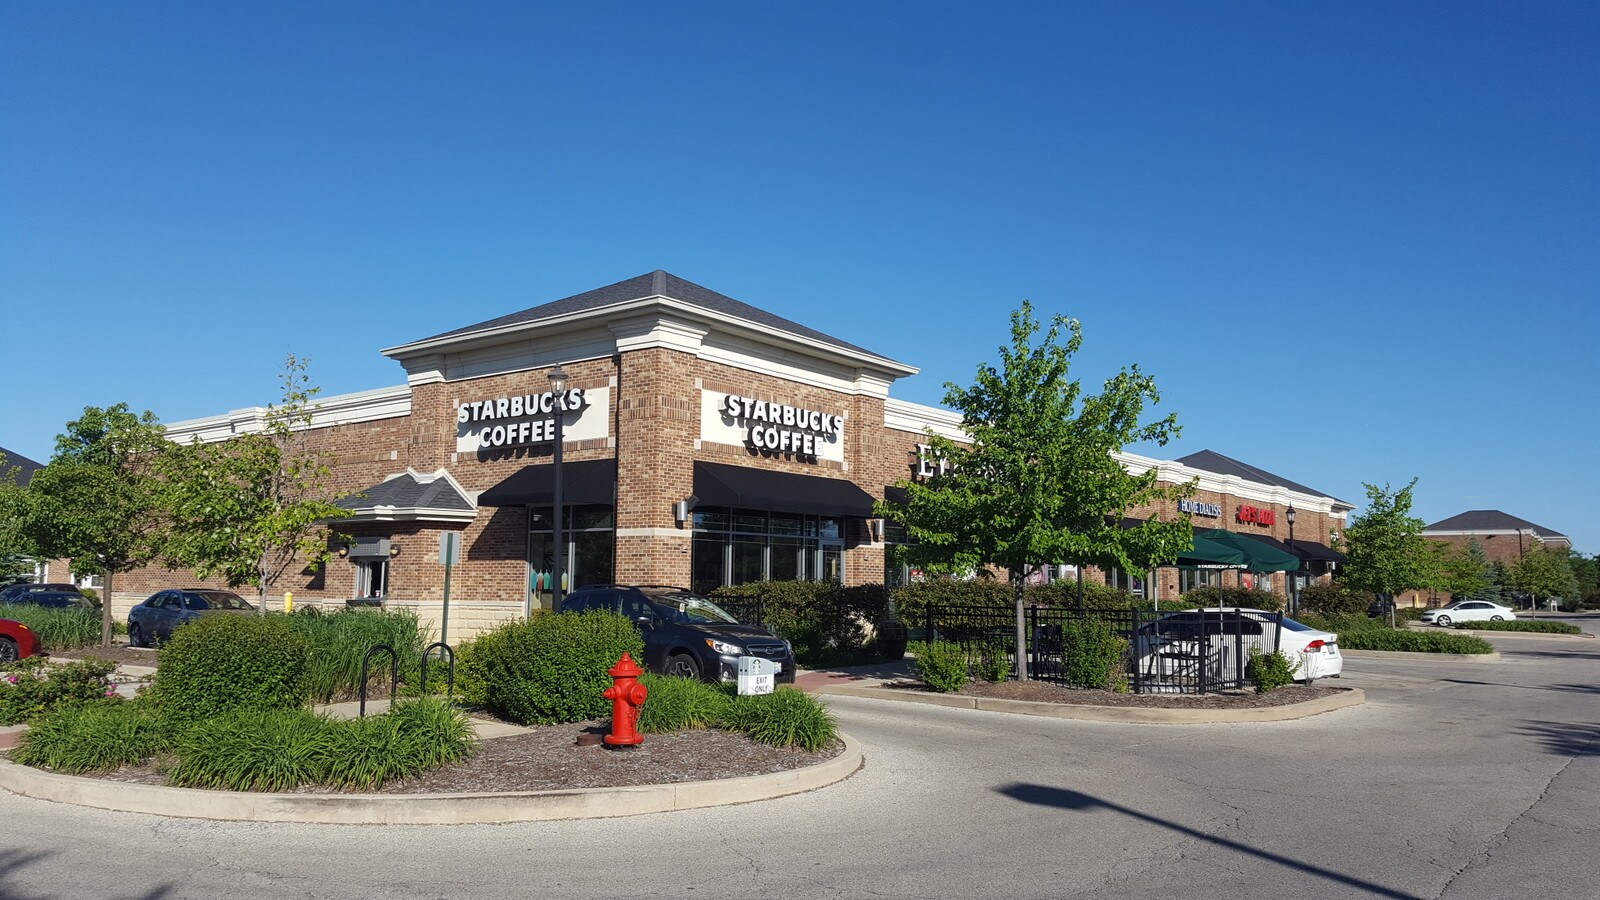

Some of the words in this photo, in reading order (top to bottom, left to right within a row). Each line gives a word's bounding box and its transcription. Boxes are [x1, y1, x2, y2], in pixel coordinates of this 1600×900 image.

[459, 388, 582, 423] STARBUCKS
[728, 394, 843, 435] STARBUCKS
[479, 419, 555, 448] COFFEE
[752, 425, 824, 456] COFFEE
[1181, 500, 1199, 514] HOME
[755, 685, 768, 693] ONLY
[756, 676, 767, 684] EXIT
